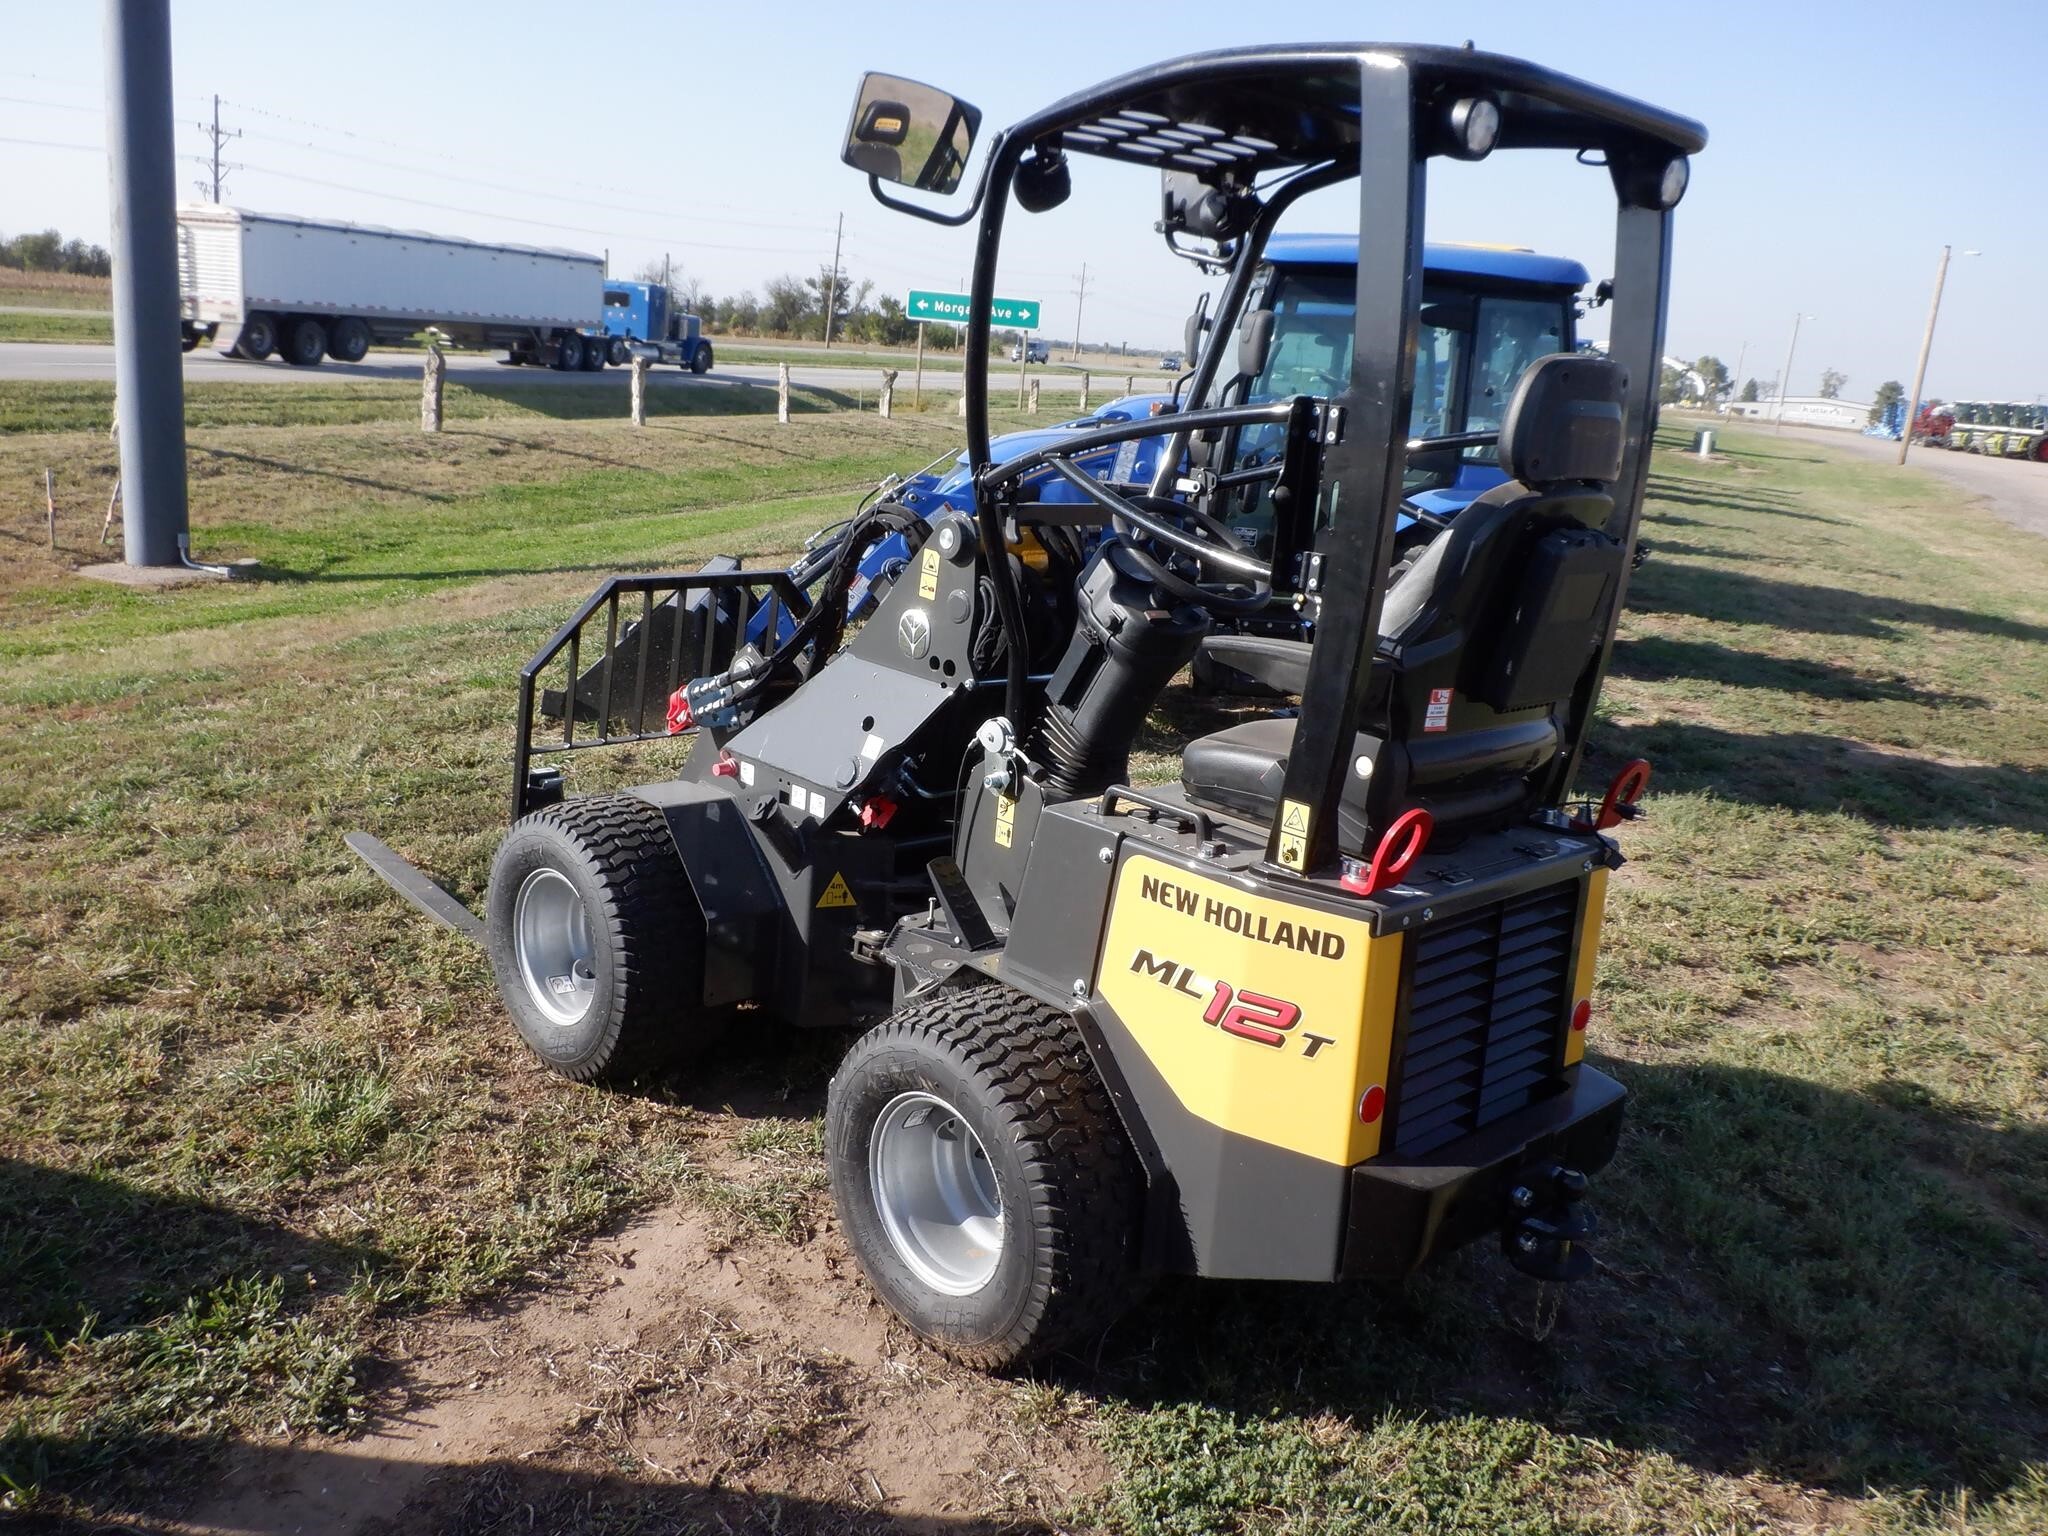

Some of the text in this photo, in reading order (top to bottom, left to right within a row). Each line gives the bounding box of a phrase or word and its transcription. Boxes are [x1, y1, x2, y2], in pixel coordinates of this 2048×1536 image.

[934, 300, 1012, 319] Morga Ave
[1141, 874, 1345, 961] NEW HOLLAND
